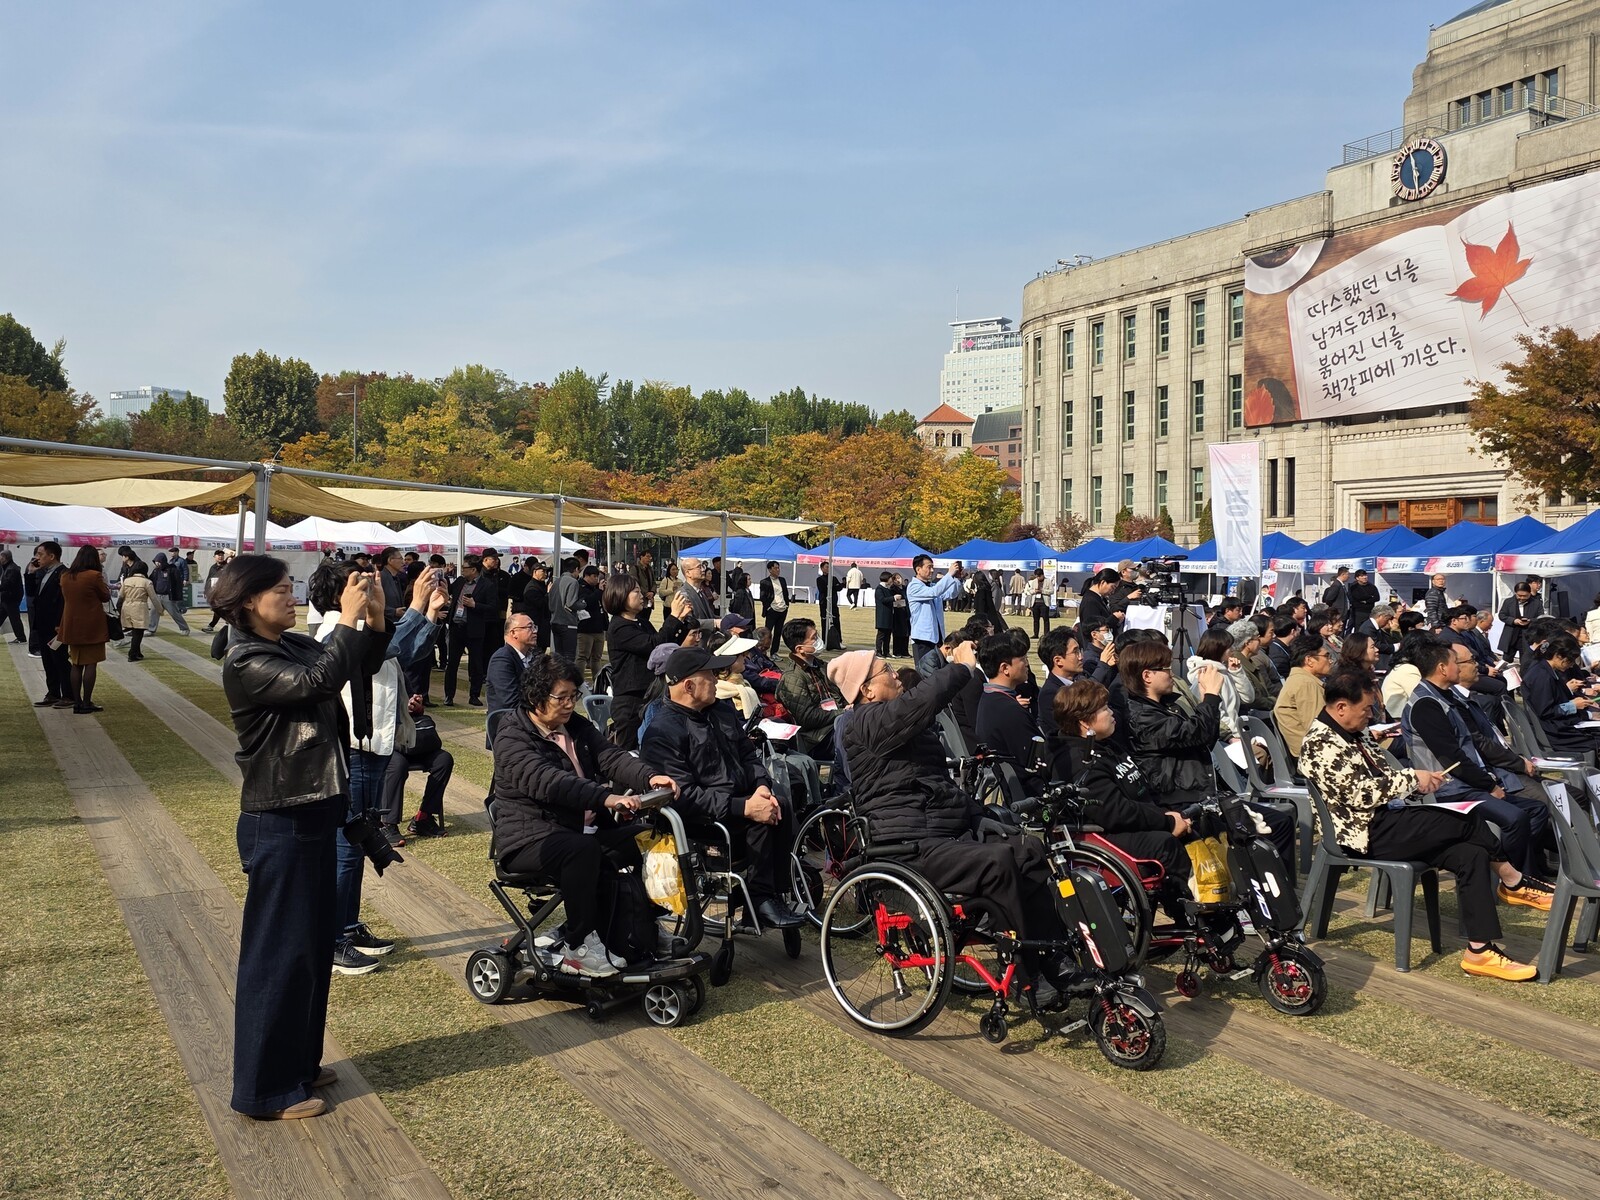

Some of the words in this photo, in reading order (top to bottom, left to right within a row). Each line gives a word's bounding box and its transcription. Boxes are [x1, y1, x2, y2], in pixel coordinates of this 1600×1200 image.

[1306, 274, 1381, 317] 따스했던
[1385, 257, 1419, 283] 너를
[1311, 302, 1397, 350] 남겨두려고,
[1318, 340, 1367, 380] 붉어진
[1371, 325, 1405, 350] 너를
[1322, 358, 1396, 402] 책갈피에
[1400, 336, 1466, 367] 끼운다.
